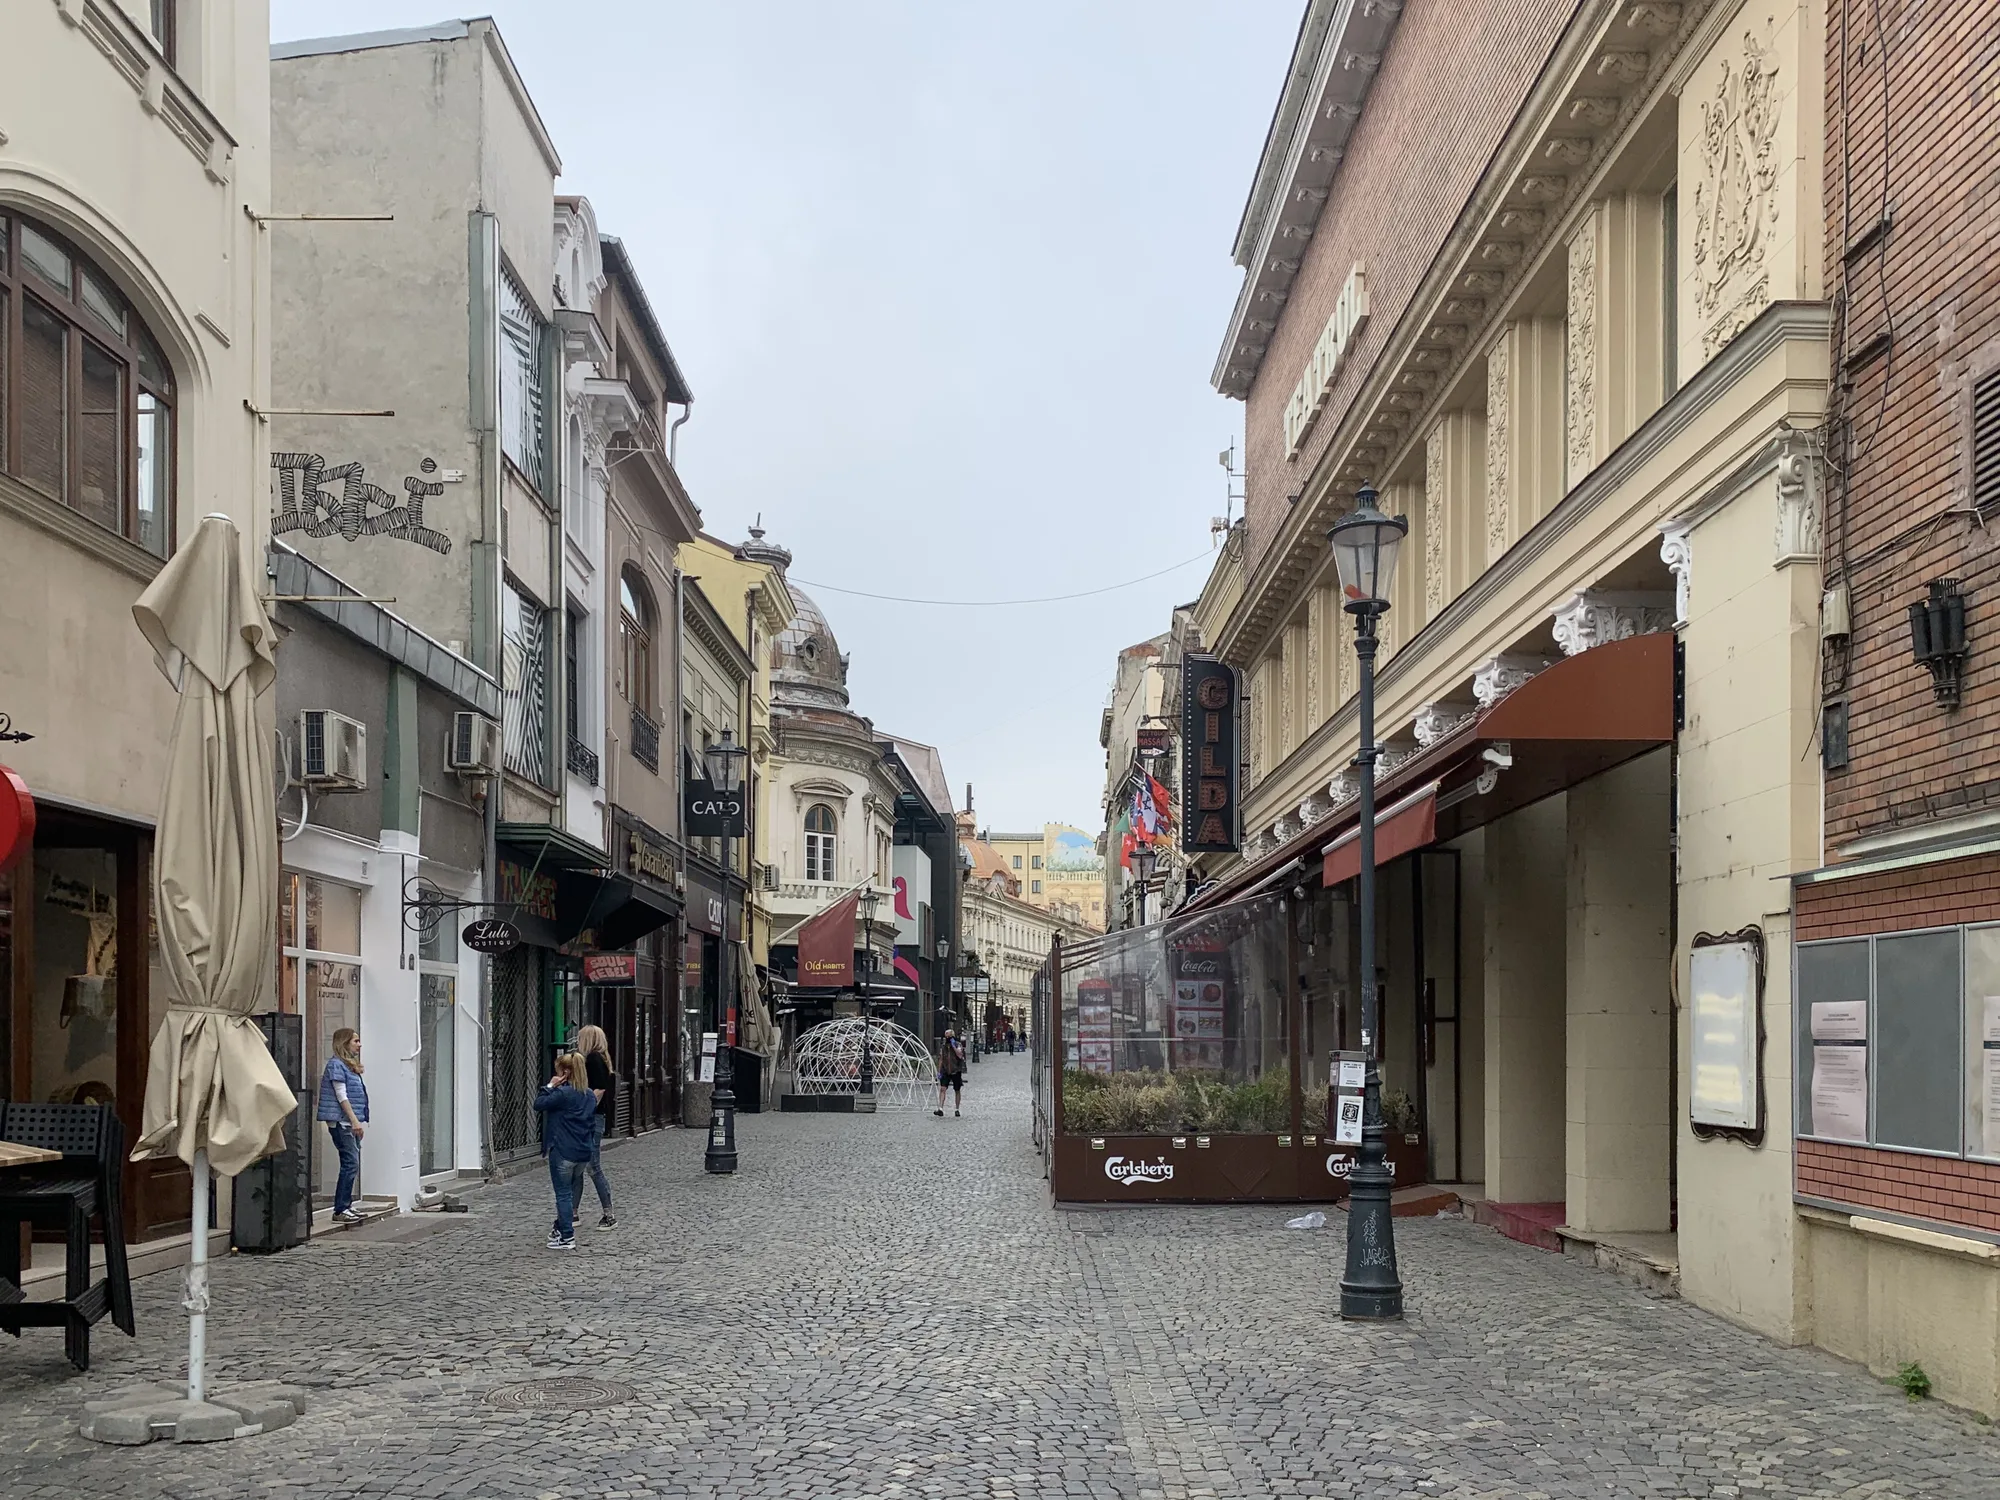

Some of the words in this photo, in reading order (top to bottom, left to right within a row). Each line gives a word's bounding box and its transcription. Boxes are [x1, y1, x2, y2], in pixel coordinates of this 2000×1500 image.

[1284, 260, 1370, 463] TEATRUL
[1195, 676, 1230, 845] GILDA
[474, 921, 510, 940] Lulu
[589, 956, 627, 969] SOUL
[805, 959, 825, 971] Old
[588, 966, 631, 982] REBEL
[1105, 1157, 1174, 1184] Carlsberg
